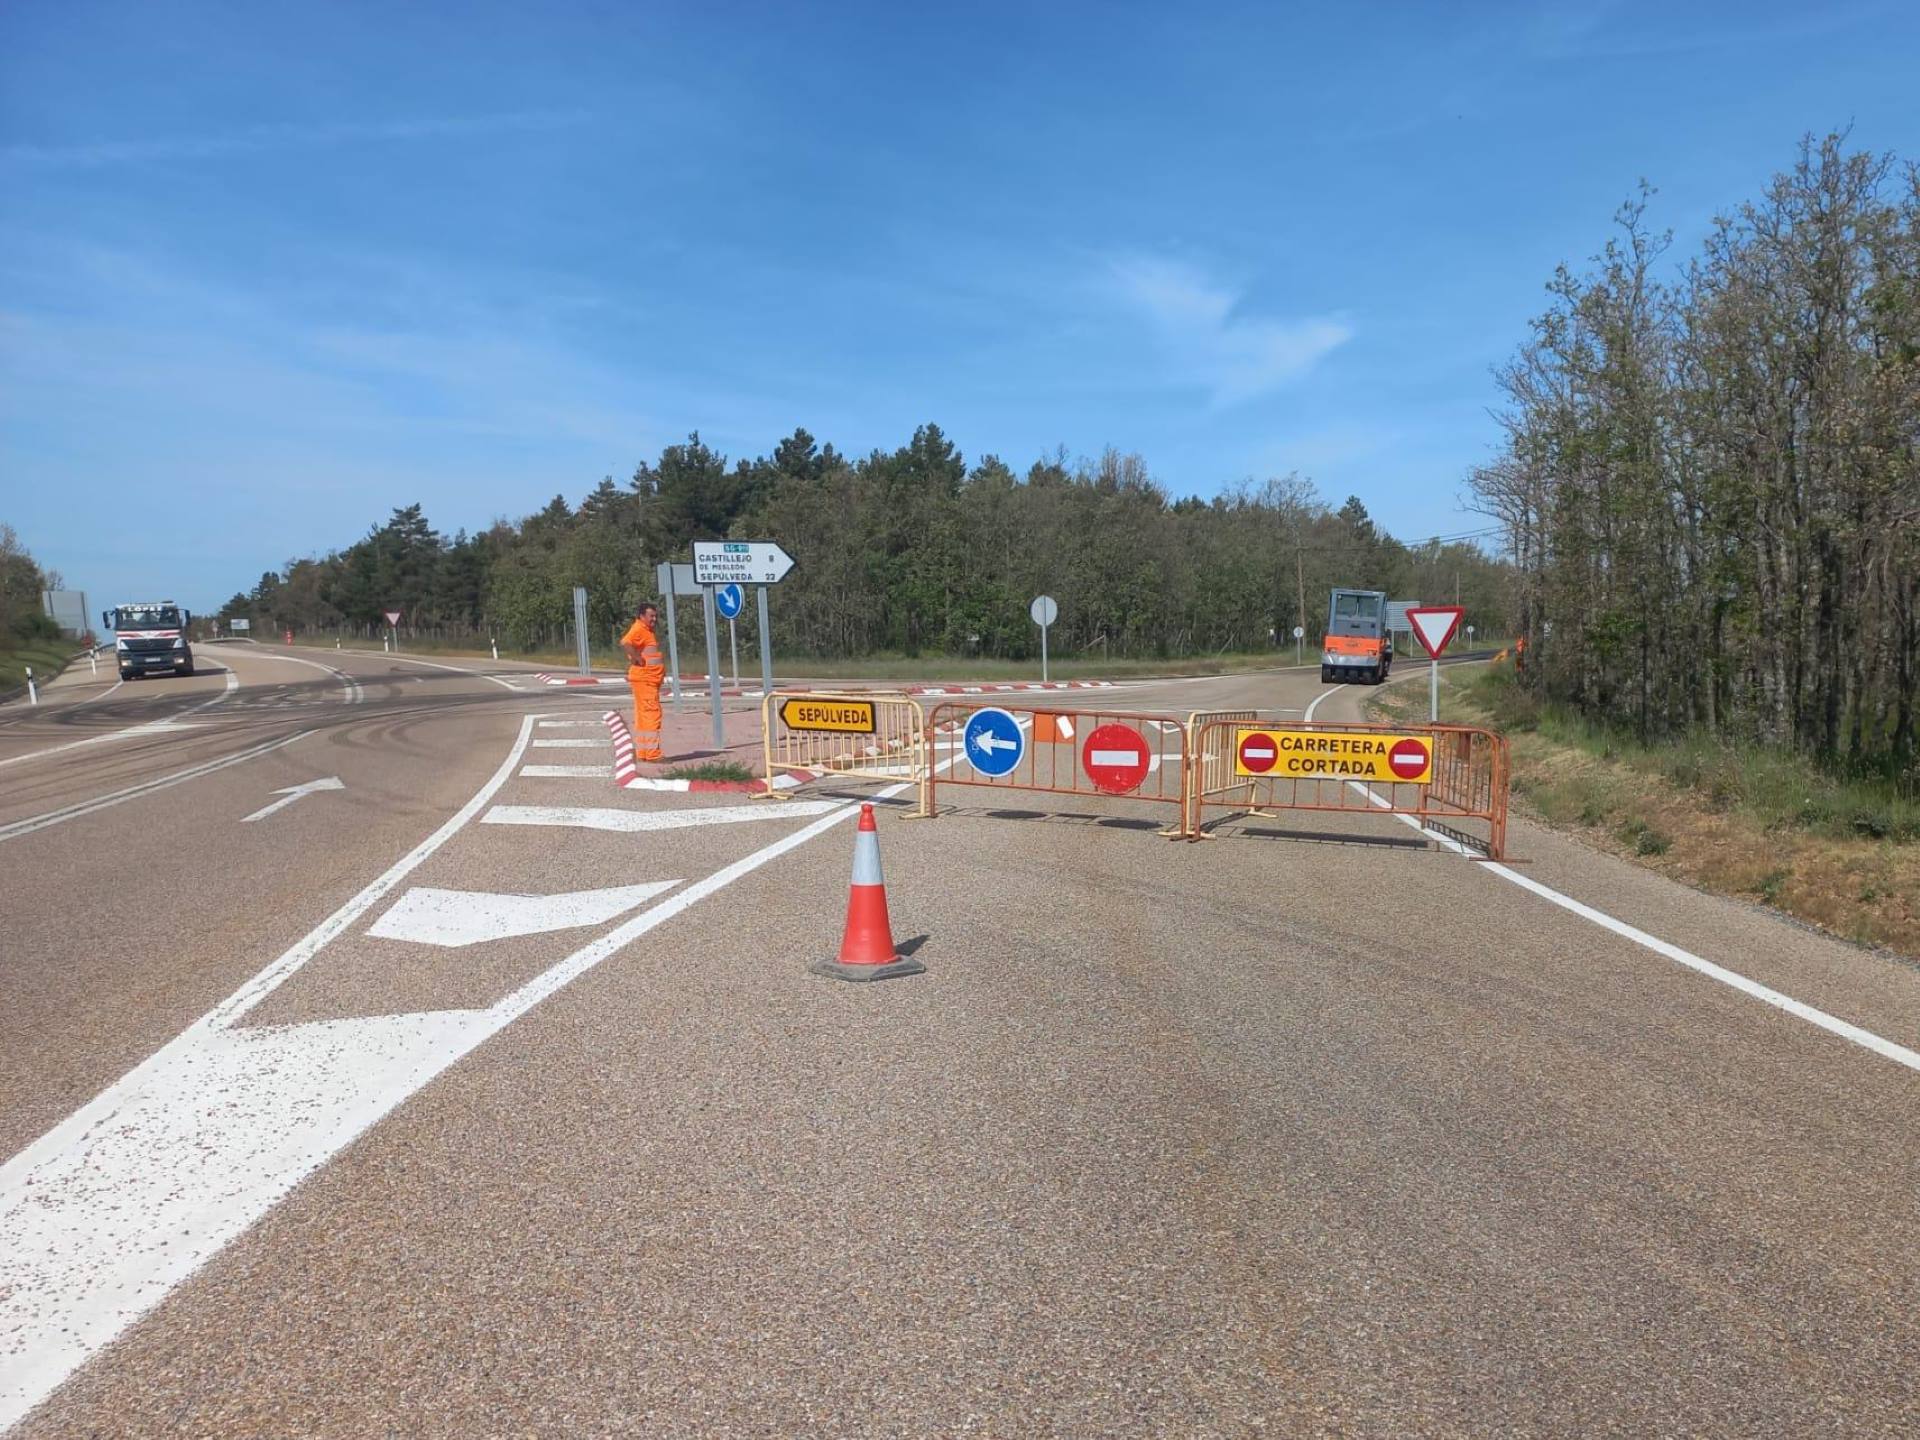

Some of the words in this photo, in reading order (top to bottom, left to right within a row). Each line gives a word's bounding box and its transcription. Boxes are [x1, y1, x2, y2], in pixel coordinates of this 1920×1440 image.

[699, 554, 752, 562] CASTILLEJO
[700, 571, 753, 581] SEPÚLVEDA
[798, 706, 869, 724] SEPÚLVEDA
[1280, 736, 1387, 755] CARRETERA
[1287, 758, 1377, 776] CORTADA
